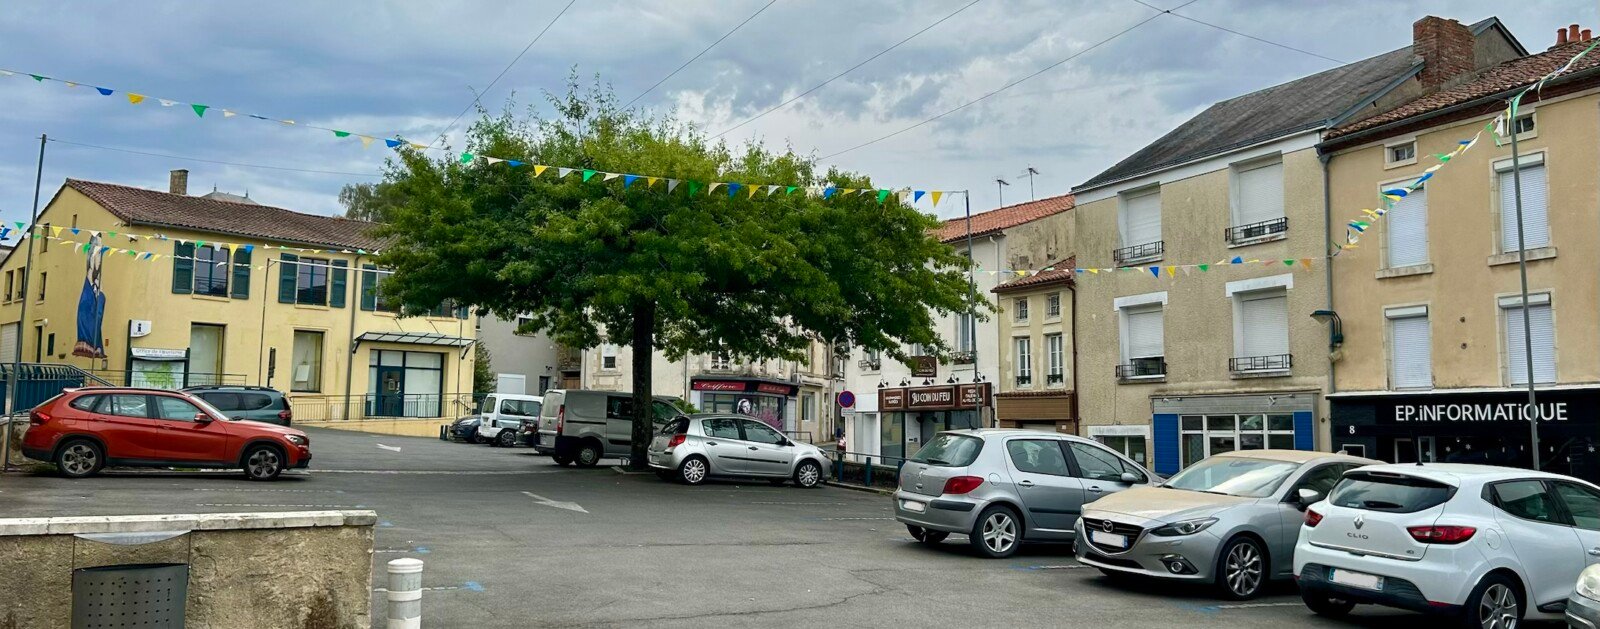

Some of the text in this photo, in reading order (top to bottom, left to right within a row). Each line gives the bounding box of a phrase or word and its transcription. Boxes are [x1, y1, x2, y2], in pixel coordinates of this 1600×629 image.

[920, 392, 931, 402] COIN
[932, 392, 938, 401] DU
[939, 391, 951, 401] FEU
[1349, 425, 1356, 434] 8
[1346, 532, 1369, 540] CLIO
